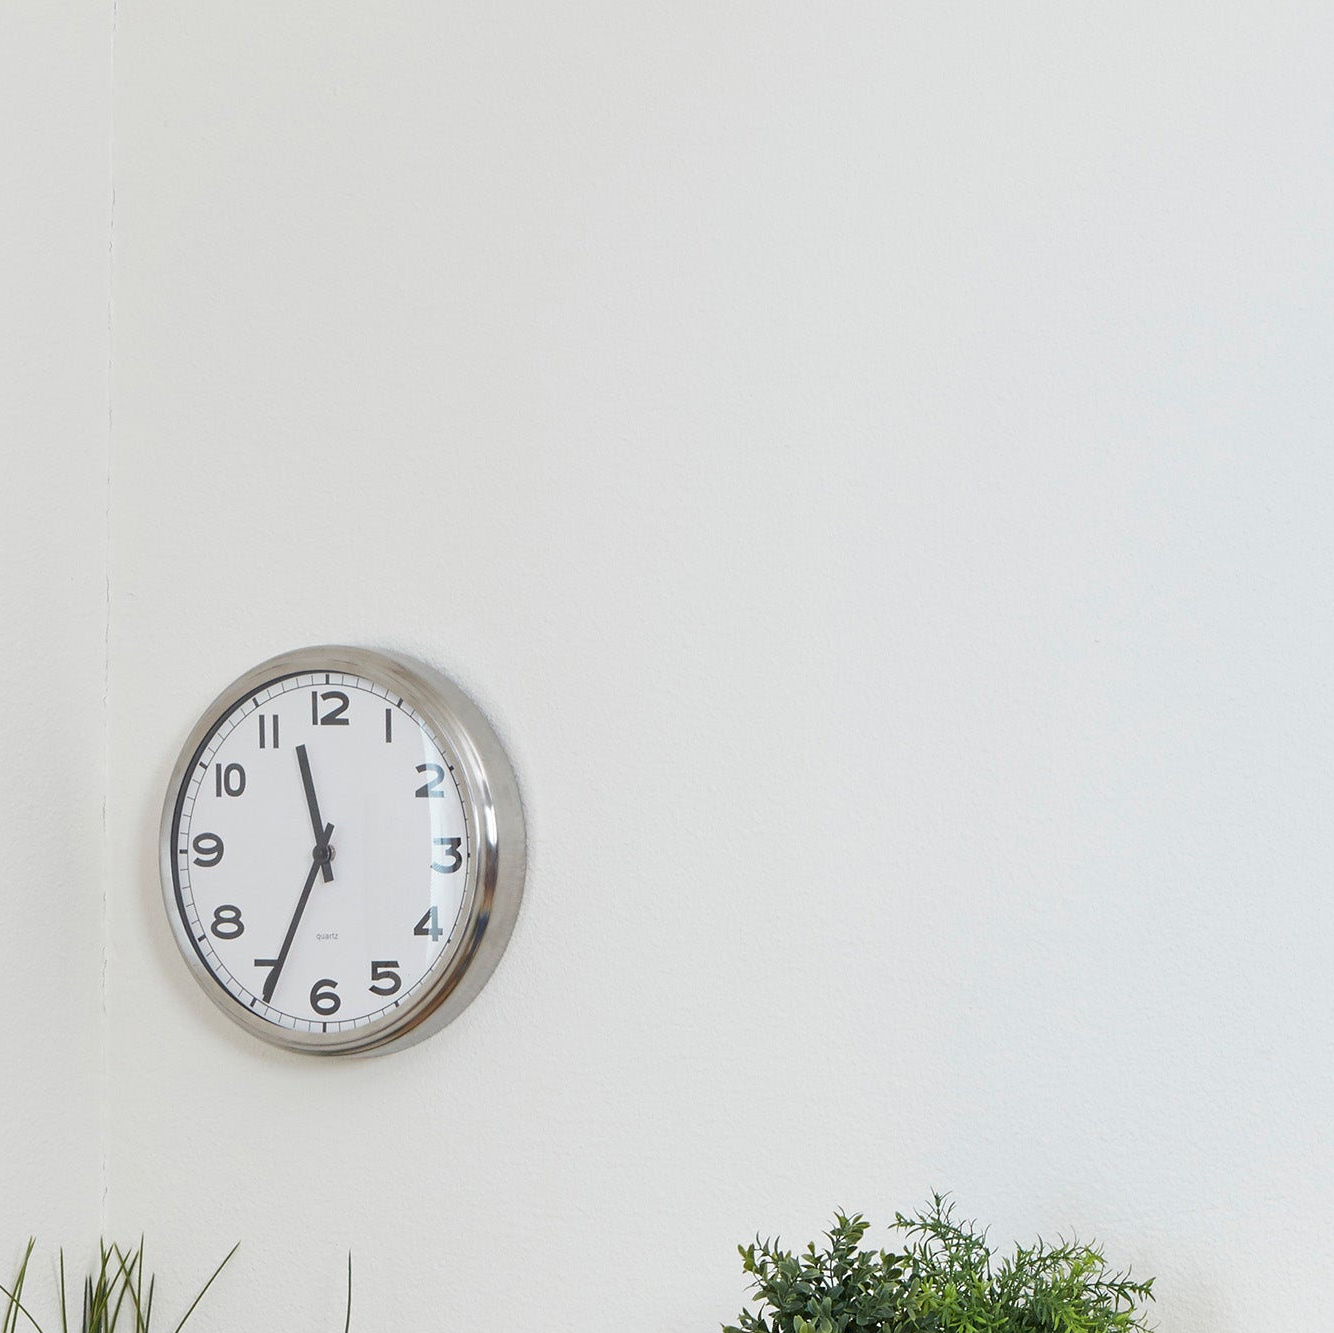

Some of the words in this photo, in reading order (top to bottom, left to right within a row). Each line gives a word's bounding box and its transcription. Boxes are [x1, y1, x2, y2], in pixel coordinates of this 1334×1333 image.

[311, 690, 350, 726] 12
[385, 708, 393, 744] 1
[258, 713, 280, 749] 11
[215, 762, 247, 798] 10
[414, 763, 446, 798] 2
[192, 832, 225, 868] 9
[430, 836, 464, 874] 3
[210, 904, 246, 940] 8
[315, 931, 340, 942] quartz
[413, 905, 444, 942] 4
[253, 958, 283, 999] 7
[368, 959, 403, 996] 5
[309, 978, 342, 1016] 6
